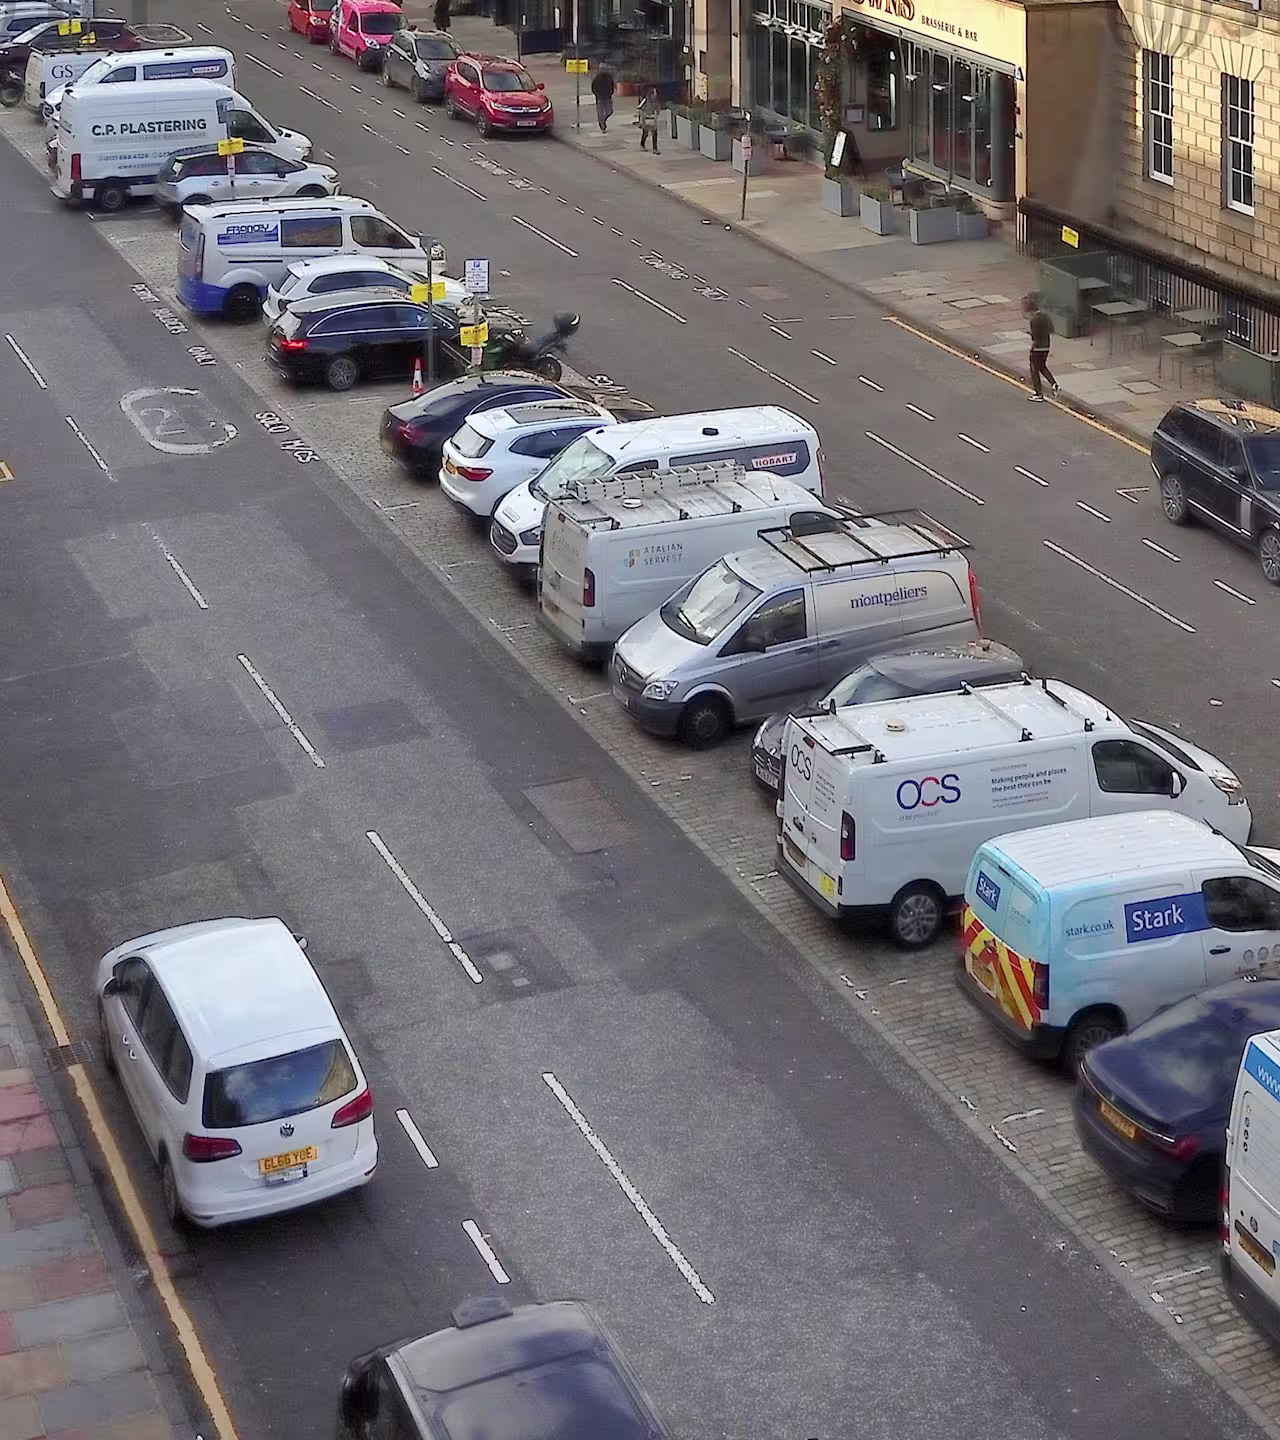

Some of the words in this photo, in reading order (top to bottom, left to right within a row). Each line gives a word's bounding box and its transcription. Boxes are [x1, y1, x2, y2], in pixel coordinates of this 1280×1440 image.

[921, 15, 956, 35] BRASSERIE
[964, 29, 978, 42] BAR
[51, 65, 73, 79] GS
[91, 124, 117, 136] C.P.
[120, 118, 207, 134] PLASTERING
[187, 345, 218, 366] ONLY
[254, 411, 291, 435] SOLO
[755, 454, 793, 467] HOBART
[643, 554, 683, 566] SERVEST
[850, 586, 928, 608] montpeliers
[791, 744, 812, 781] OCS
[991, 775, 1013, 785] Making
[1014, 772, 1035, 782] people
[1048, 767, 1067, 777] places
[1003, 783, 1016, 791] best
[1017, 781, 1031, 790] they
[896, 773, 962, 810] OCS
[978, 877, 1000, 906] Stark
[1065, 920, 1115, 937] stark.co.uk
[1131, 903, 1185, 933] Stark
